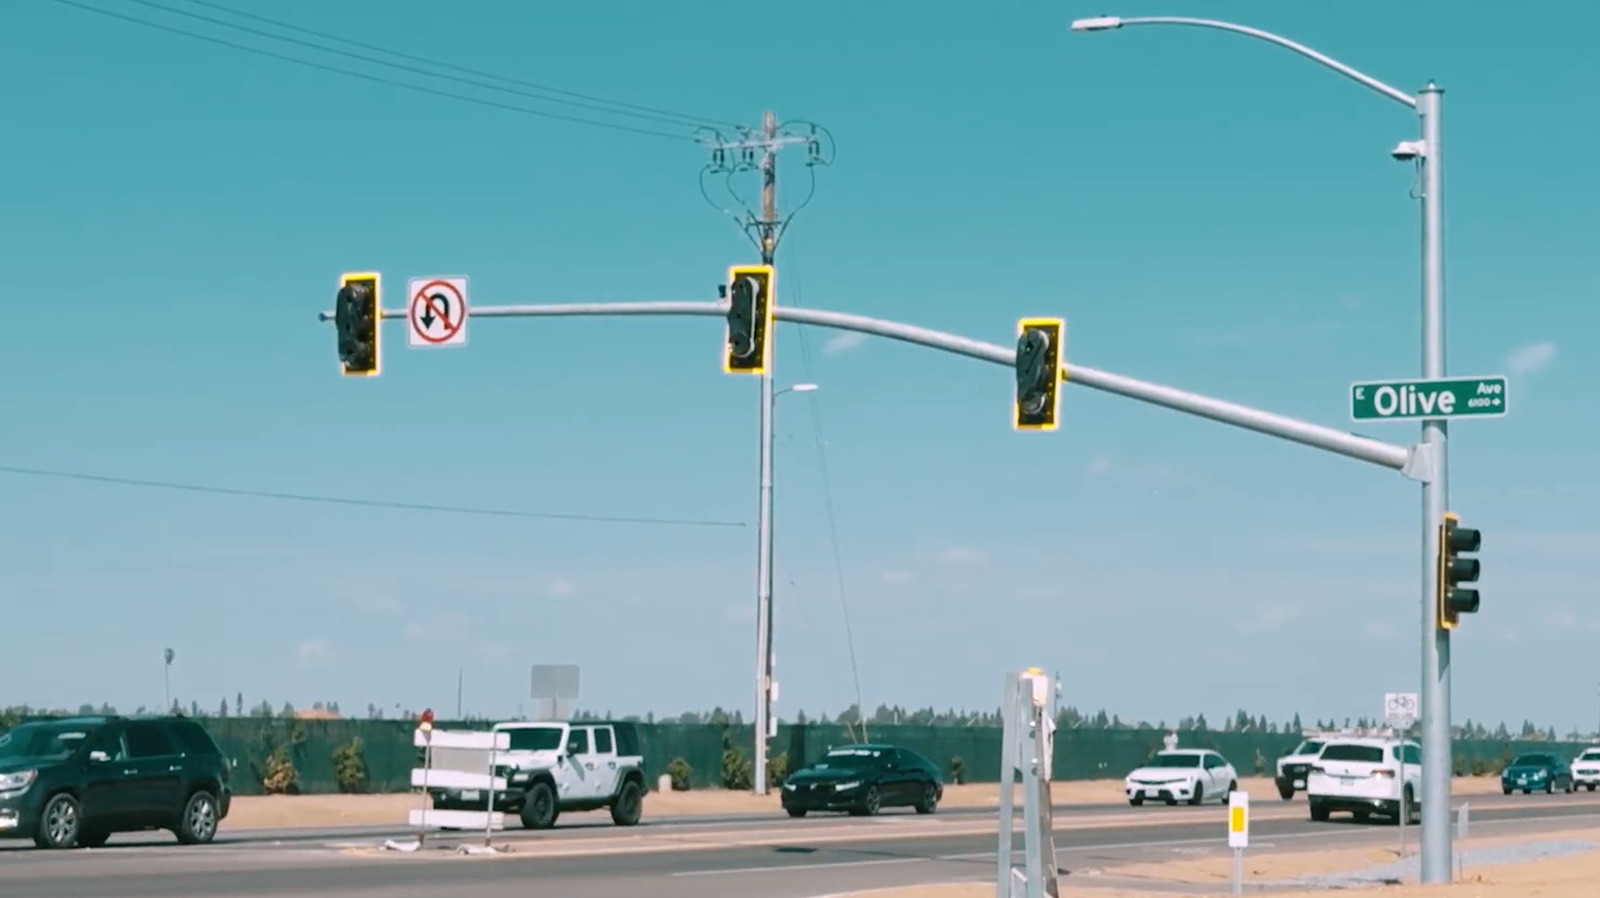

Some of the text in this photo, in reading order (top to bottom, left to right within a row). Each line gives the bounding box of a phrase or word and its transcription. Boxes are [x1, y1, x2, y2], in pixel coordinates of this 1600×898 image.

[1355, 382, 1502, 416] E Olive Ave
